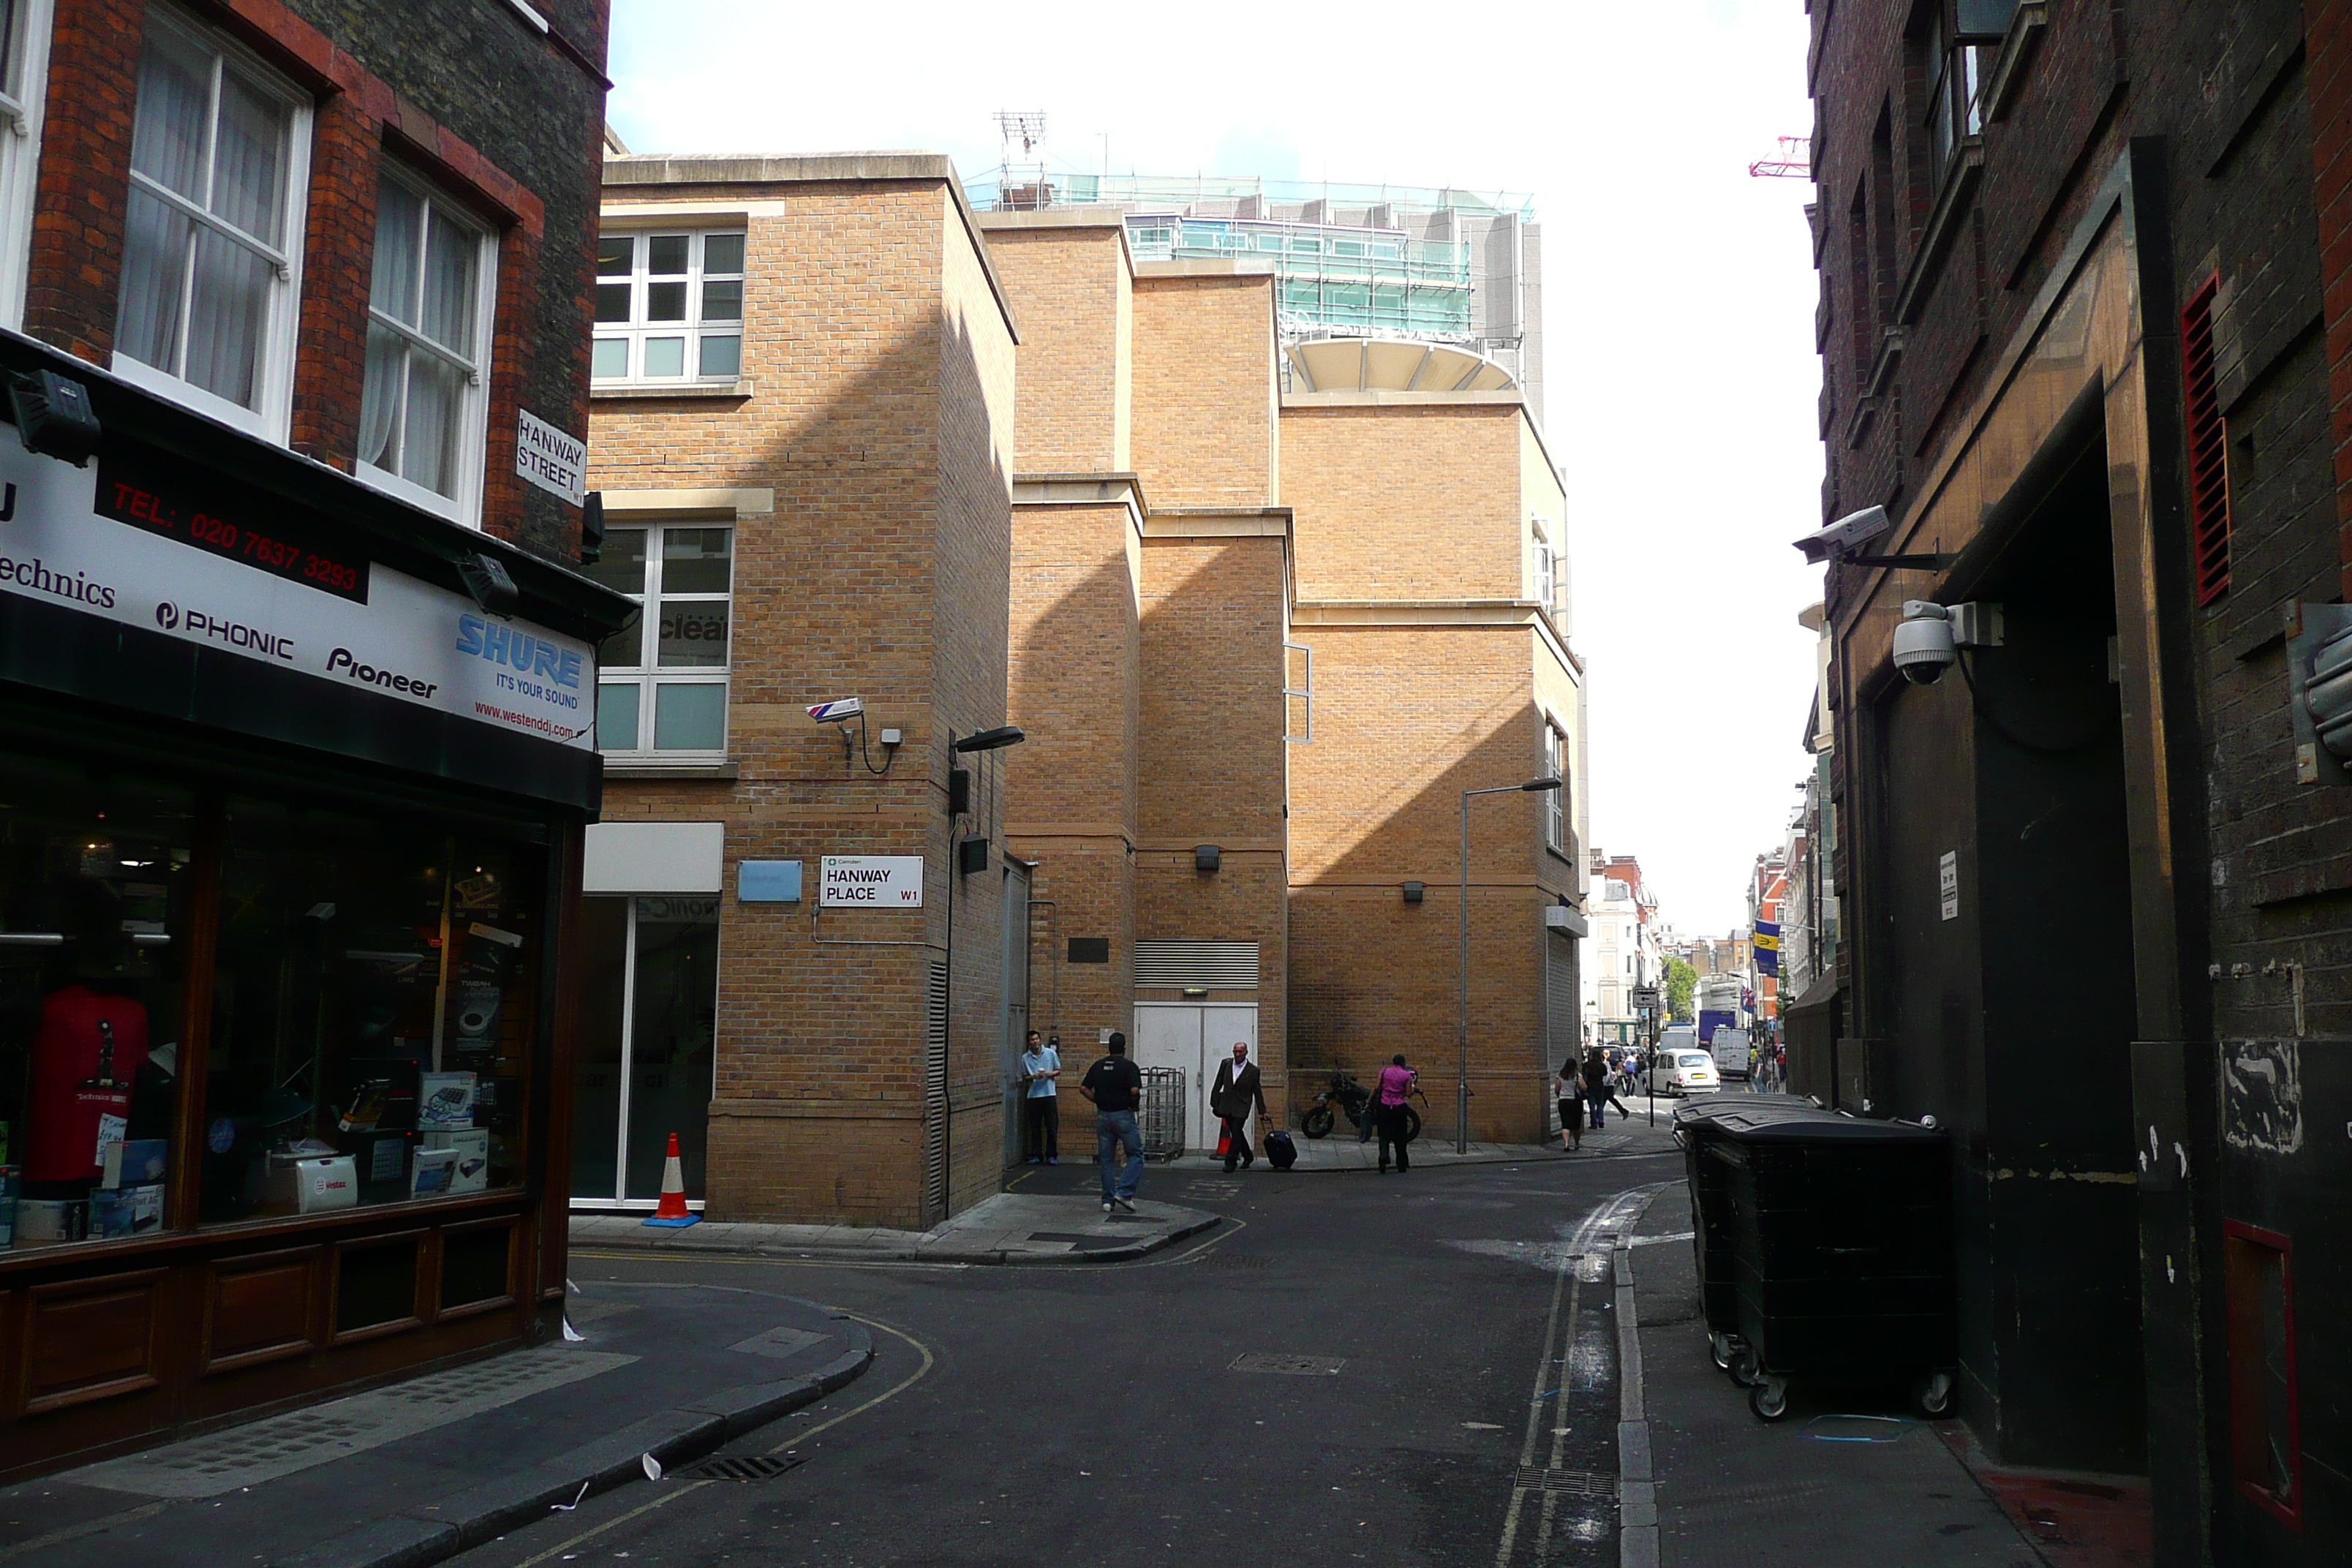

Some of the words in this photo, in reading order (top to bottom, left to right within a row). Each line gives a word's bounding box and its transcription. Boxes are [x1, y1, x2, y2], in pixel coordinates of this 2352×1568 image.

[520, 418, 581, 467] HANWAY
[519, 446, 576, 491] STREET
[114, 482, 177, 528] TEL:
[191, 513, 238, 548] 020
[244, 532, 301, 569] 7637
[304, 554, 357, 591] 3293
[0, 557, 116, 608] echnics
[186, 609, 294, 660] PHONIC
[456, 614, 582, 689] SHURE
[326, 647, 438, 698] Pioneer
[497, 673, 514, 690] IT'S
[517, 679, 543, 699] YOUR
[546, 688, 578, 709] SOUND
[475, 701, 573, 738] www.westenddj.com
[827, 870, 892, 883] HANWAY
[827, 887, 875, 900] PLACE
[900, 891, 918, 900] W1
